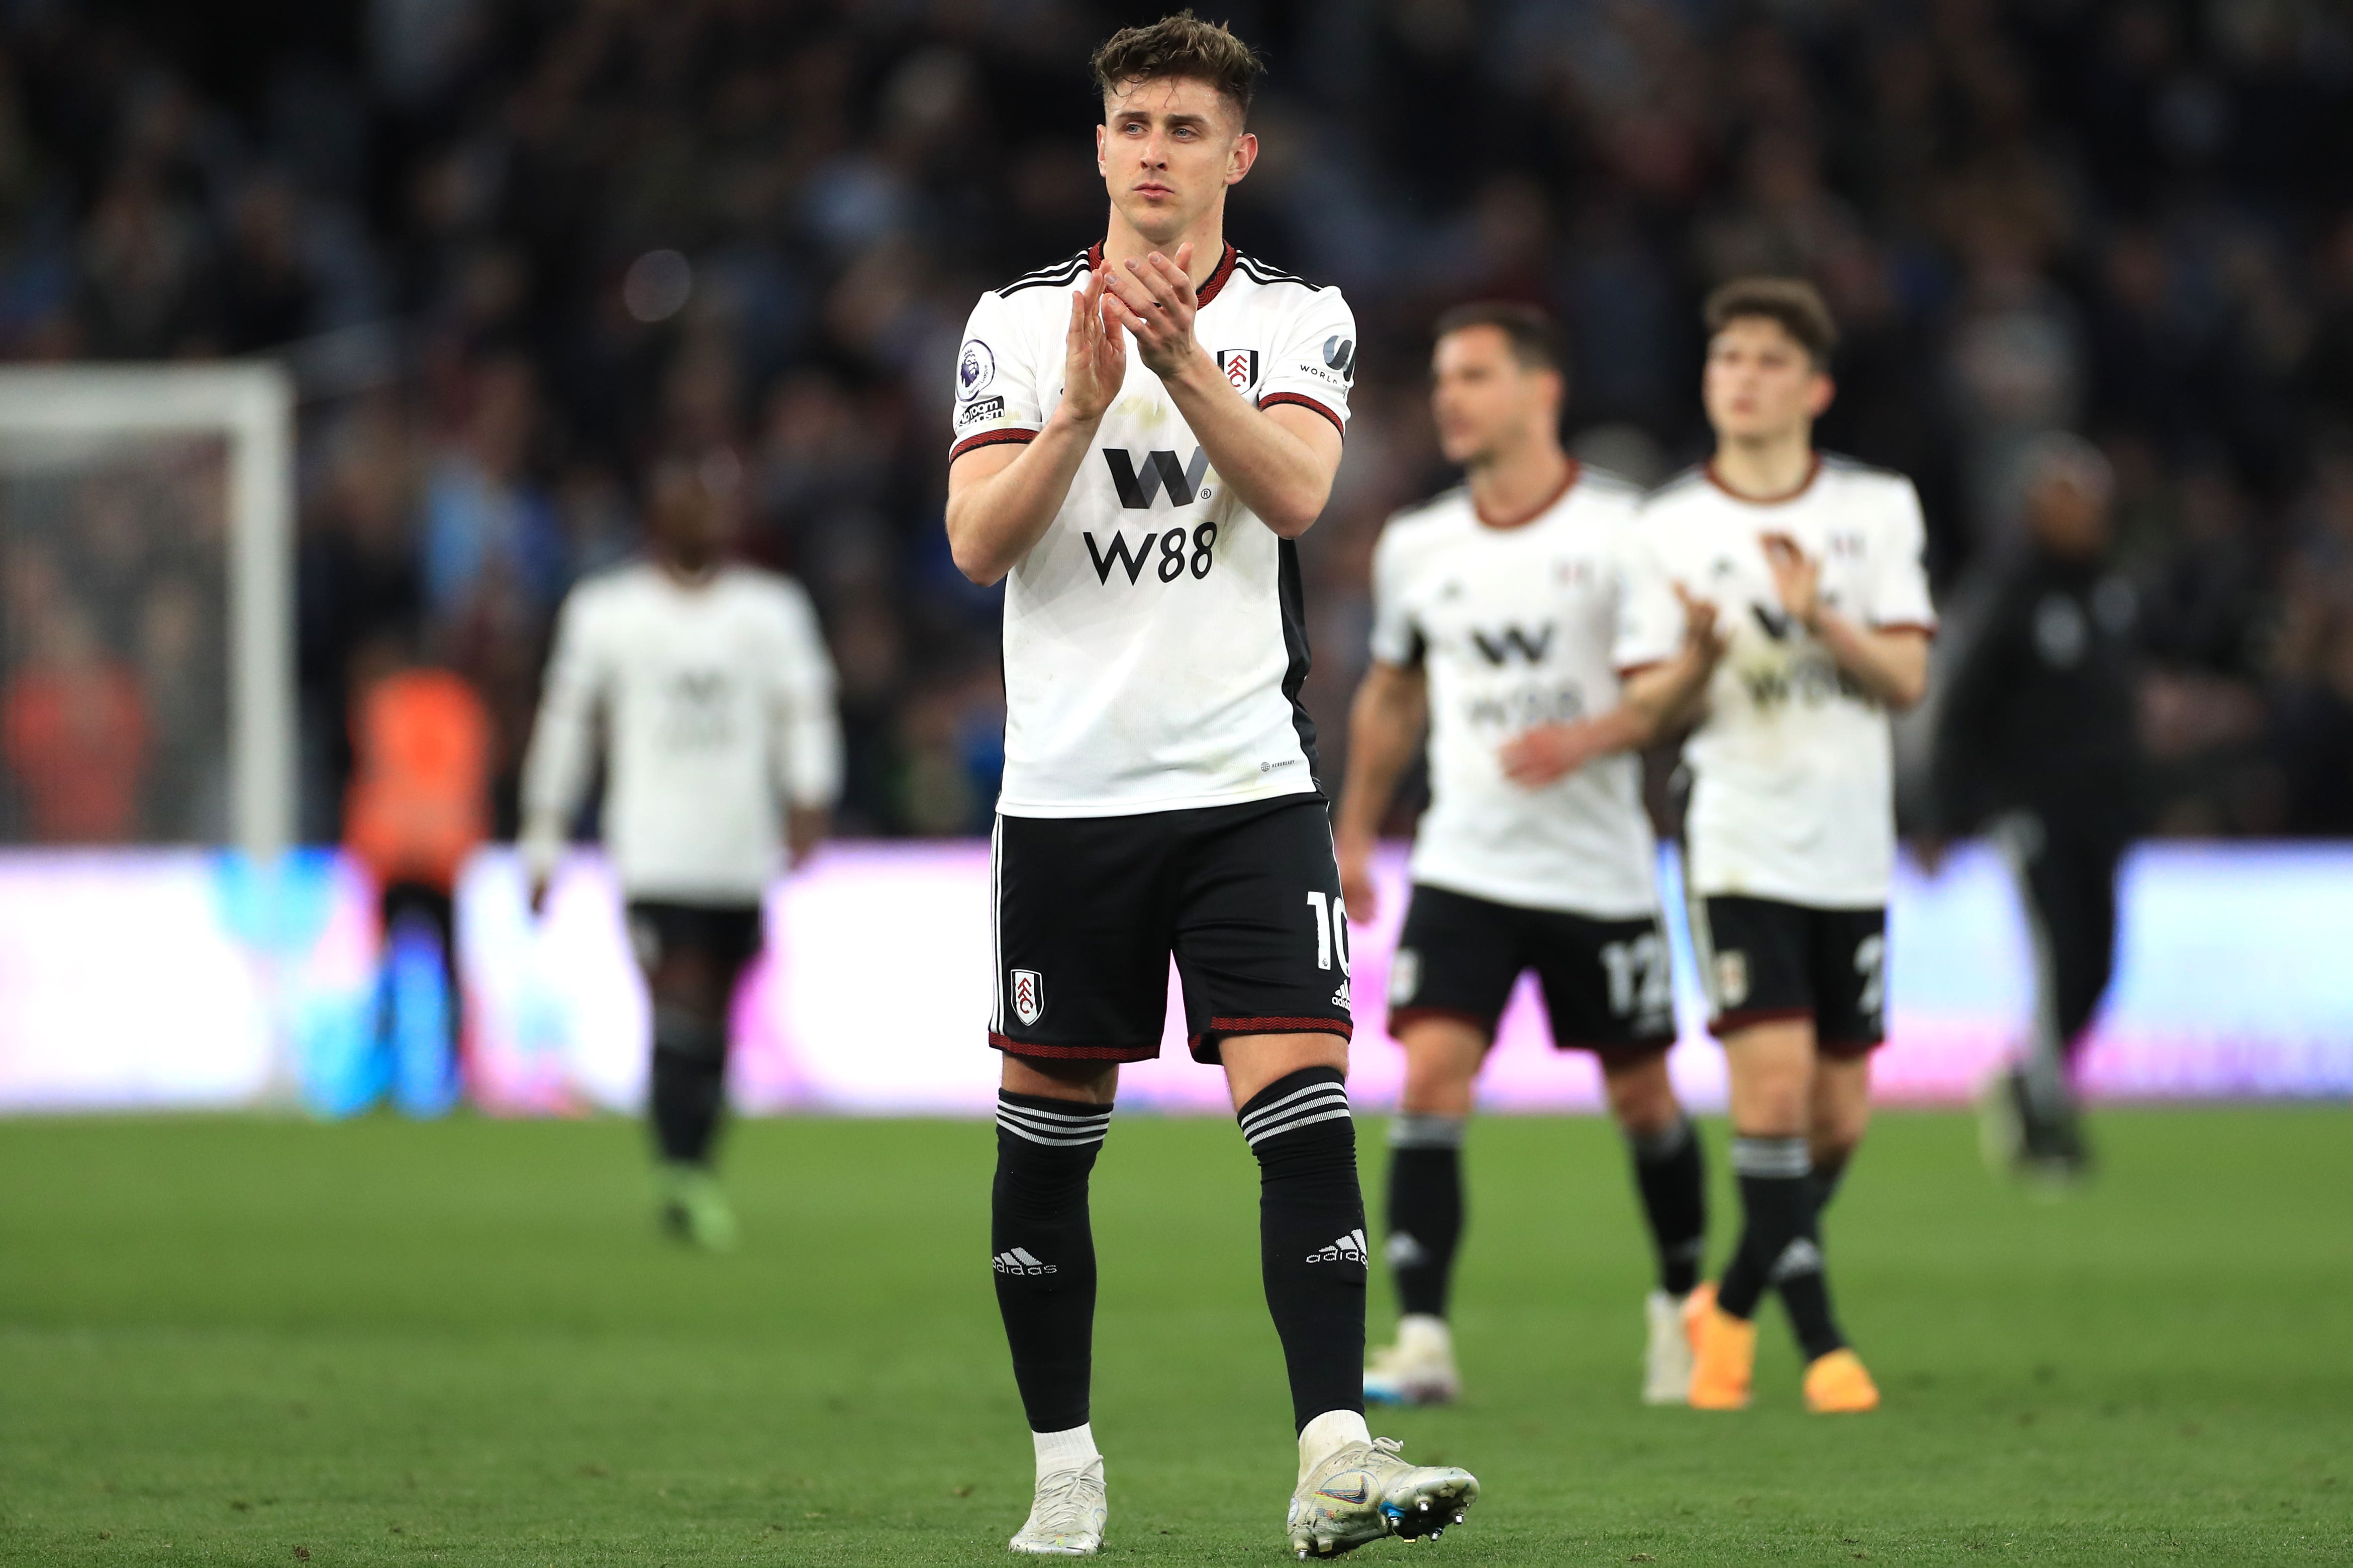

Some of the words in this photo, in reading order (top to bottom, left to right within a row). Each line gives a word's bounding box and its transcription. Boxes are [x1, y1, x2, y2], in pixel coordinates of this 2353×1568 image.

[969, 400, 999, 419] room
[1083, 521, 1217, 586] W88
[1307, 891, 1350, 978] 10
[1017, 977, 1033, 1014] FFC
[1599, 933, 1672, 1012] 12
